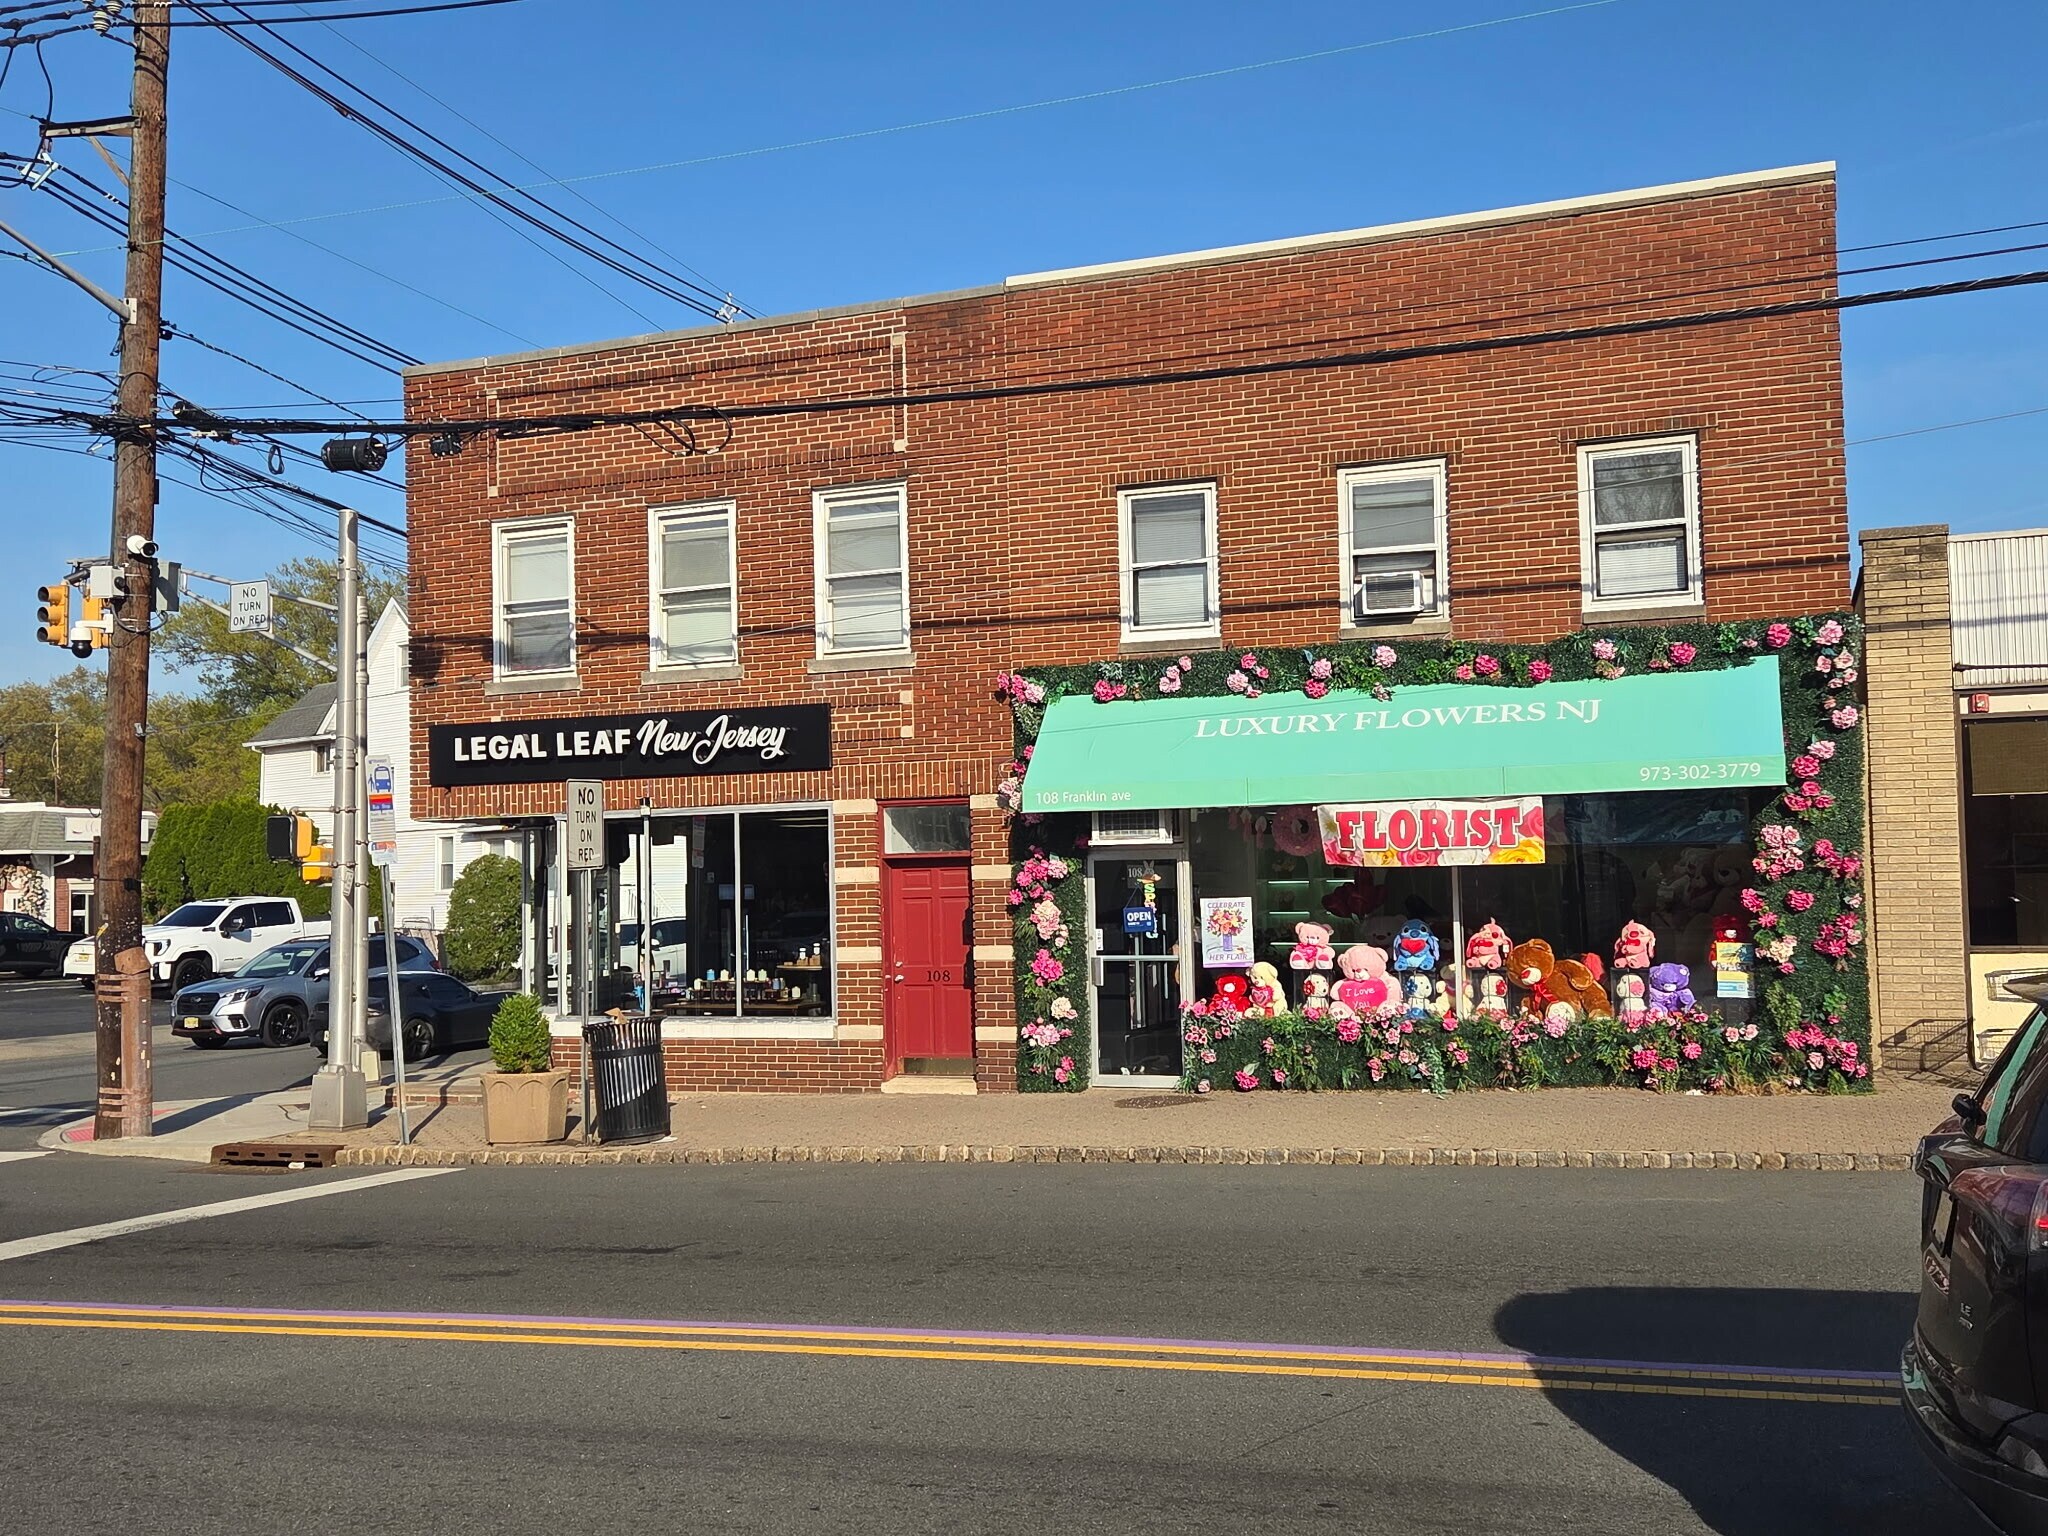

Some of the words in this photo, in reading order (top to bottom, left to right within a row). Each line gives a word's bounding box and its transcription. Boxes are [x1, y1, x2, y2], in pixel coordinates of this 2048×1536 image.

[242, 588, 257, 598] NO
[239, 601, 261, 611] TURN
[233, 616, 246, 626] ON
[249, 614, 266, 625] RED
[1194, 712, 1347, 738] LUXURY
[1353, 702, 1546, 731] FLOWERS
[1556, 699, 1602, 724] NJ
[454, 733, 548, 762] LEGAL
[556, 728, 631, 757] LEAF
[636, 718, 697, 756] New
[692, 714, 786, 765] Jersey
[1640, 762, 1761, 782] 973-302-3779
[578, 788, 595, 805] NO
[1036, 791, 1059, 805] 108
[1062, 790, 1107, 803] Franklin
[1111, 791, 1131, 801] ave
[575, 810, 597, 824] TURN
[1335, 806, 1521, 849] FLORIST
[580, 828, 593, 843] ON
[578, 847, 594, 862] RED
[1128, 868, 1143, 878] 108
[1207, 901, 1246, 909] CELEBRATE
[1126, 911, 1152, 922] OPEN
[1226, 953, 1248, 961] FLAIR
[927, 969, 951, 982] 108
[1345, 988, 1352, 997] I
[1353, 987, 1375, 997] Love
